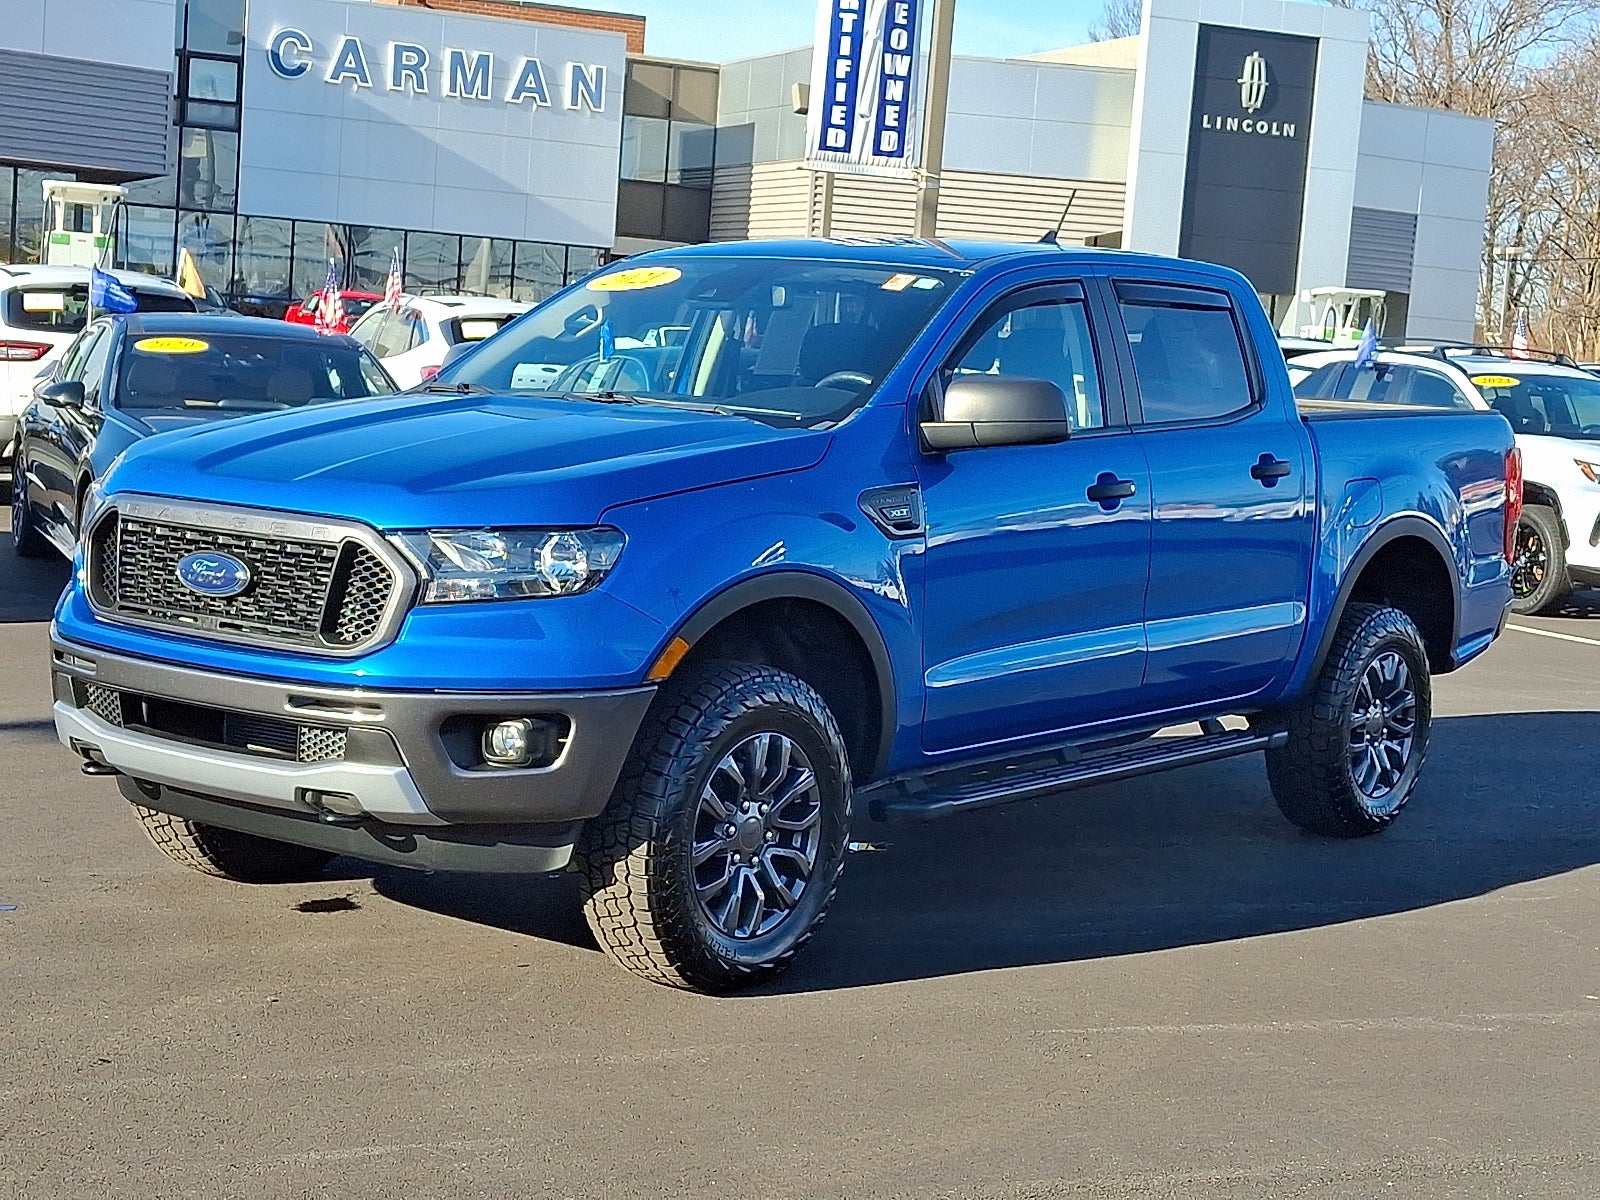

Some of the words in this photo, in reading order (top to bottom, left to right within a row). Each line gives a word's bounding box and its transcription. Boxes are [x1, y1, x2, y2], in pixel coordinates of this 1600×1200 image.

[266, 28, 608, 113] CARMAN
[879, 2, 911, 151] EOWNED
[1202, 114, 1296, 137] LINCOLN
[125, 503, 329, 539] RANGER
[890, 508, 909, 517] XLT
[191, 558, 228, 580] Ford
